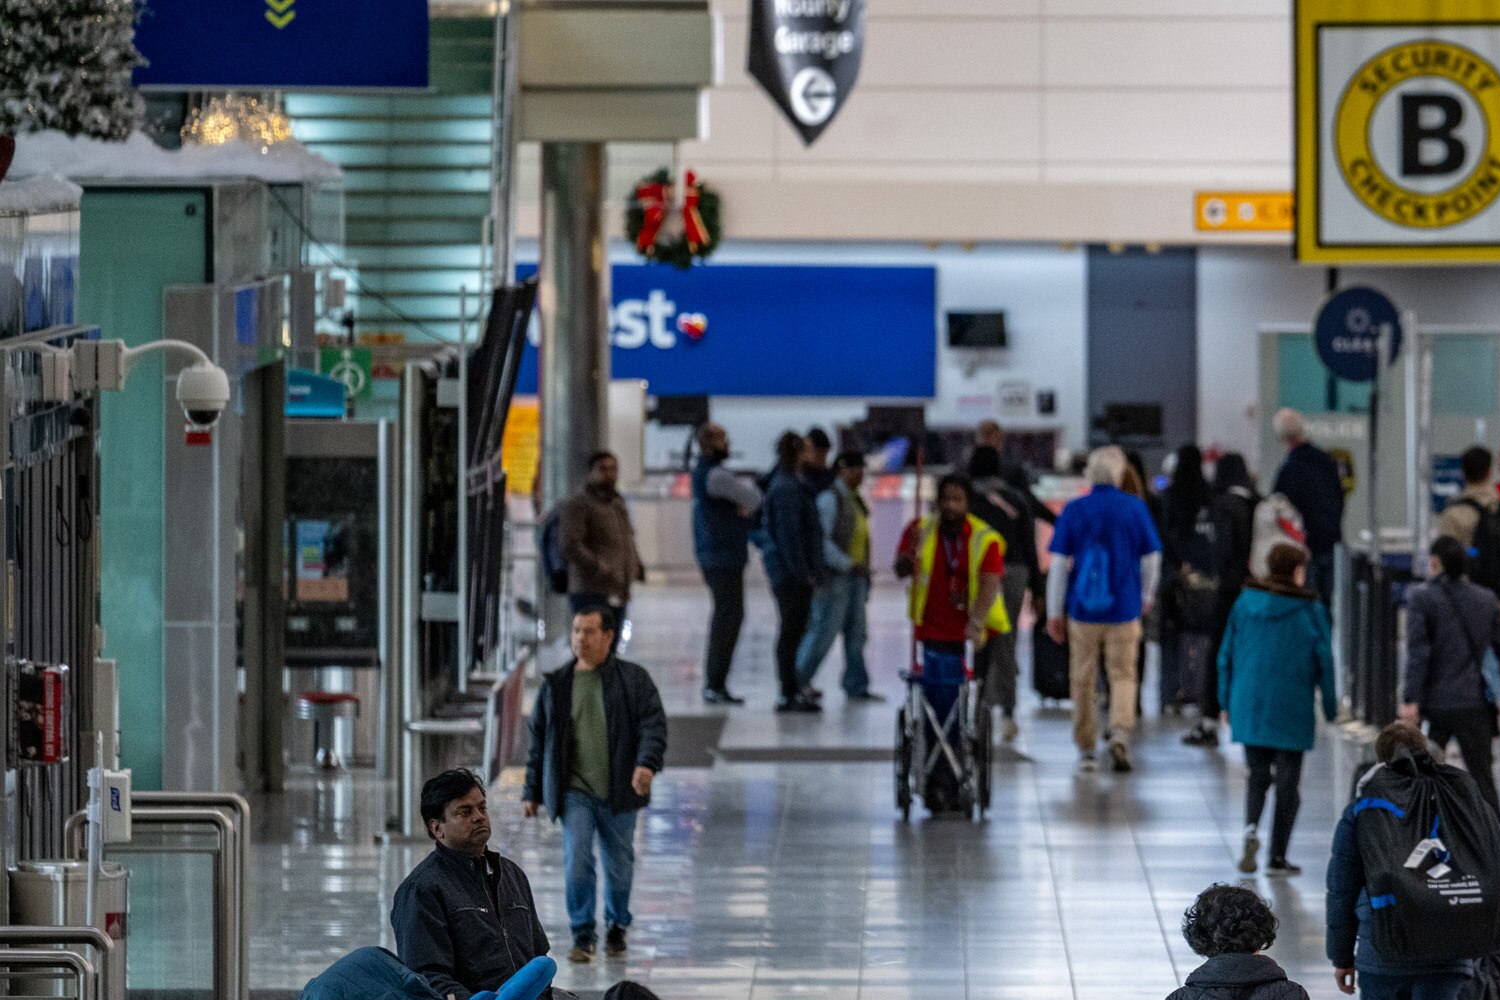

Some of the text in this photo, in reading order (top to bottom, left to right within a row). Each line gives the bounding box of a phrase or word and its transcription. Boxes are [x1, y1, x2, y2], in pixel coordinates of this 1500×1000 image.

[774, 25, 855, 60] Garage
[1358, 49, 1498, 95] SECURITY
[1402, 94, 1467, 176] B
